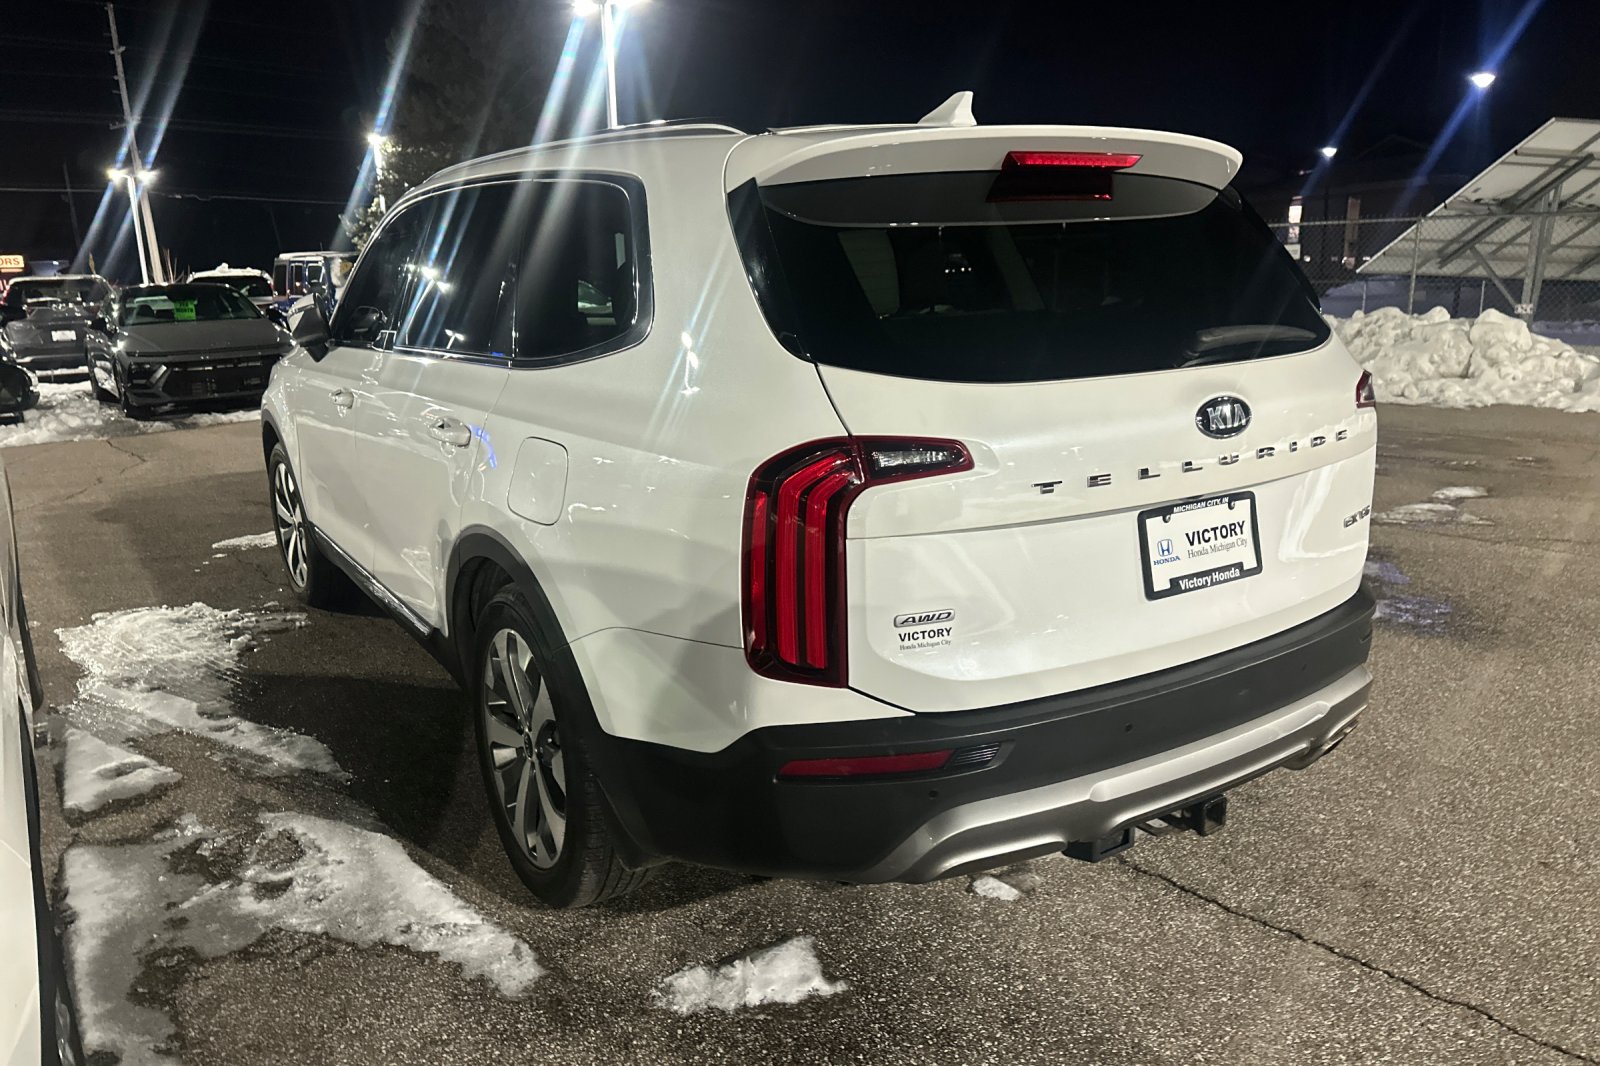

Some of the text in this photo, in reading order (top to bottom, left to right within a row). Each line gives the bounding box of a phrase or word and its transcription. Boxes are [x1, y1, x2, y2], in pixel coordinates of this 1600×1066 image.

[1206, 403, 1246, 430] KIA
[1031, 429, 1348, 494] TELLURIDE
[1173, 501, 1206, 514] MICHIGAN
[1222, 496, 1229, 504] IN
[1185, 520, 1246, 547] VICTORY
[1187, 537, 1248, 559] Honda Michigan City
[1153, 555, 1181, 566] HONDA
[1179, 567, 1240, 590] Victory Honda
[900, 612, 952, 624] AWD
[898, 626, 952, 642] VICTORY
